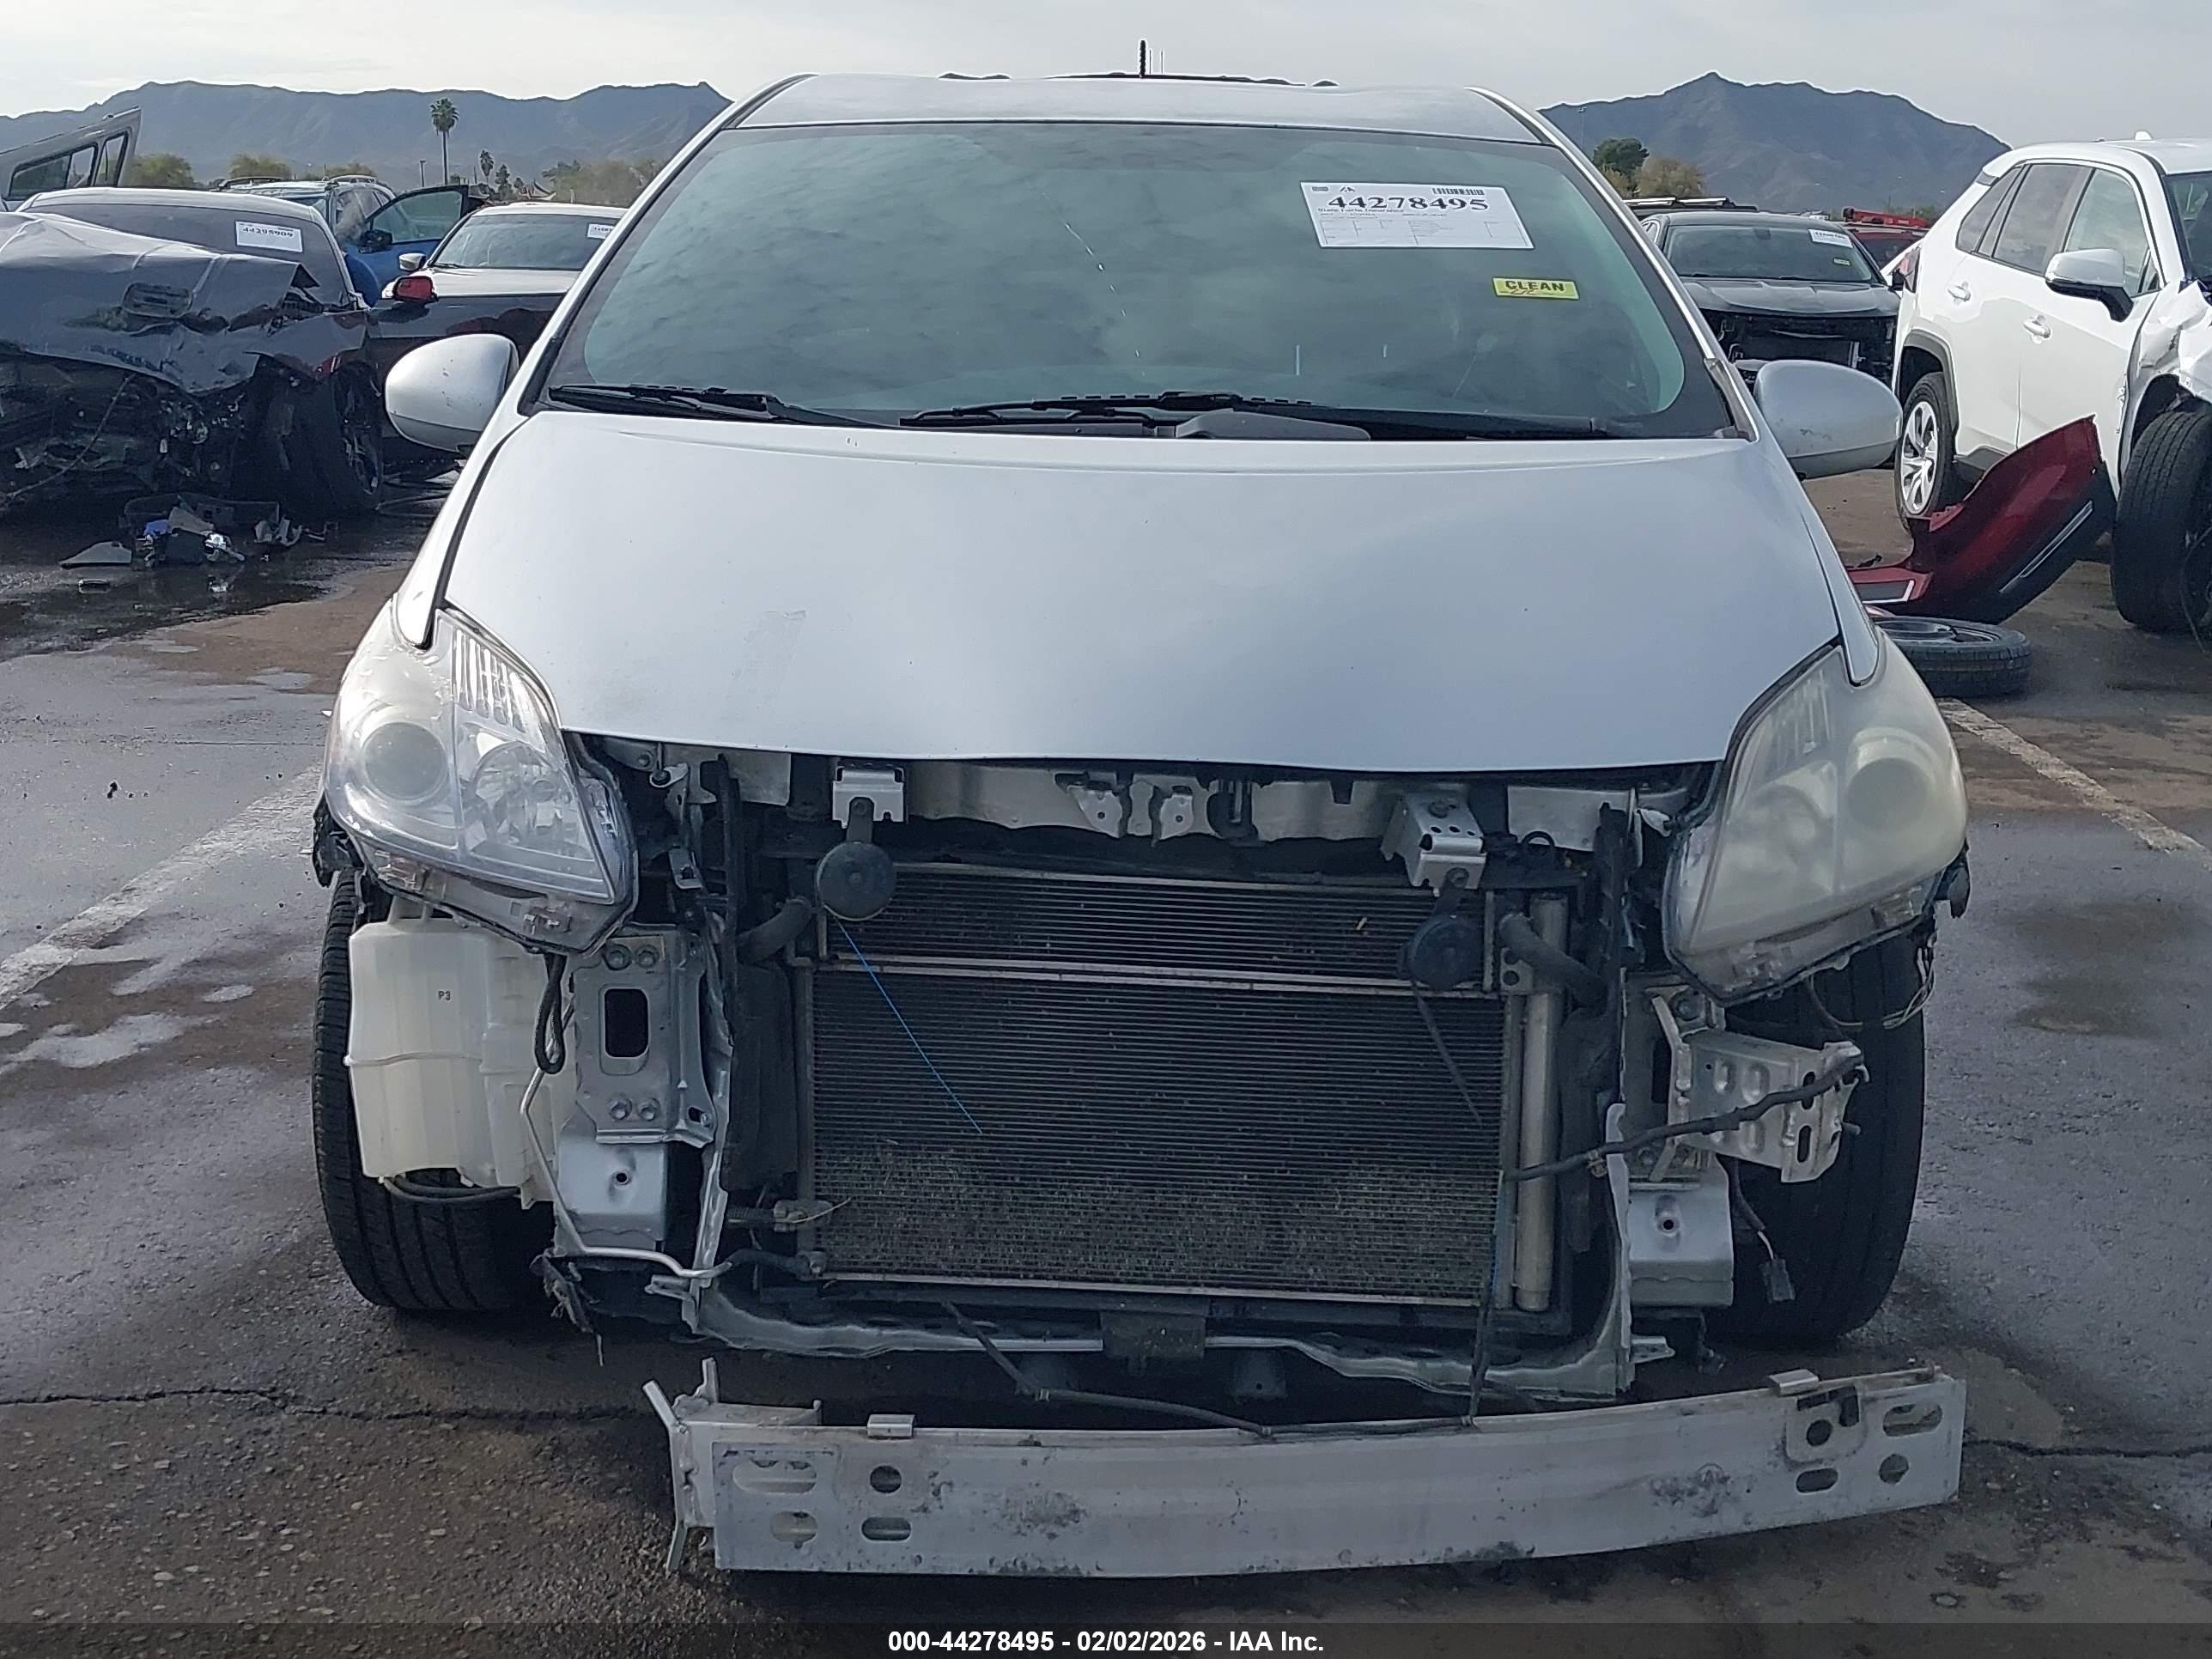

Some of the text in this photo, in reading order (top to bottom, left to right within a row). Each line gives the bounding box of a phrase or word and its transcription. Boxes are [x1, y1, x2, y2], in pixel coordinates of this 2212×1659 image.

[1328, 197, 1488, 210] 44278495
[1504, 276, 1565, 291] CLEAN
[438, 990, 451, 1001] P3
